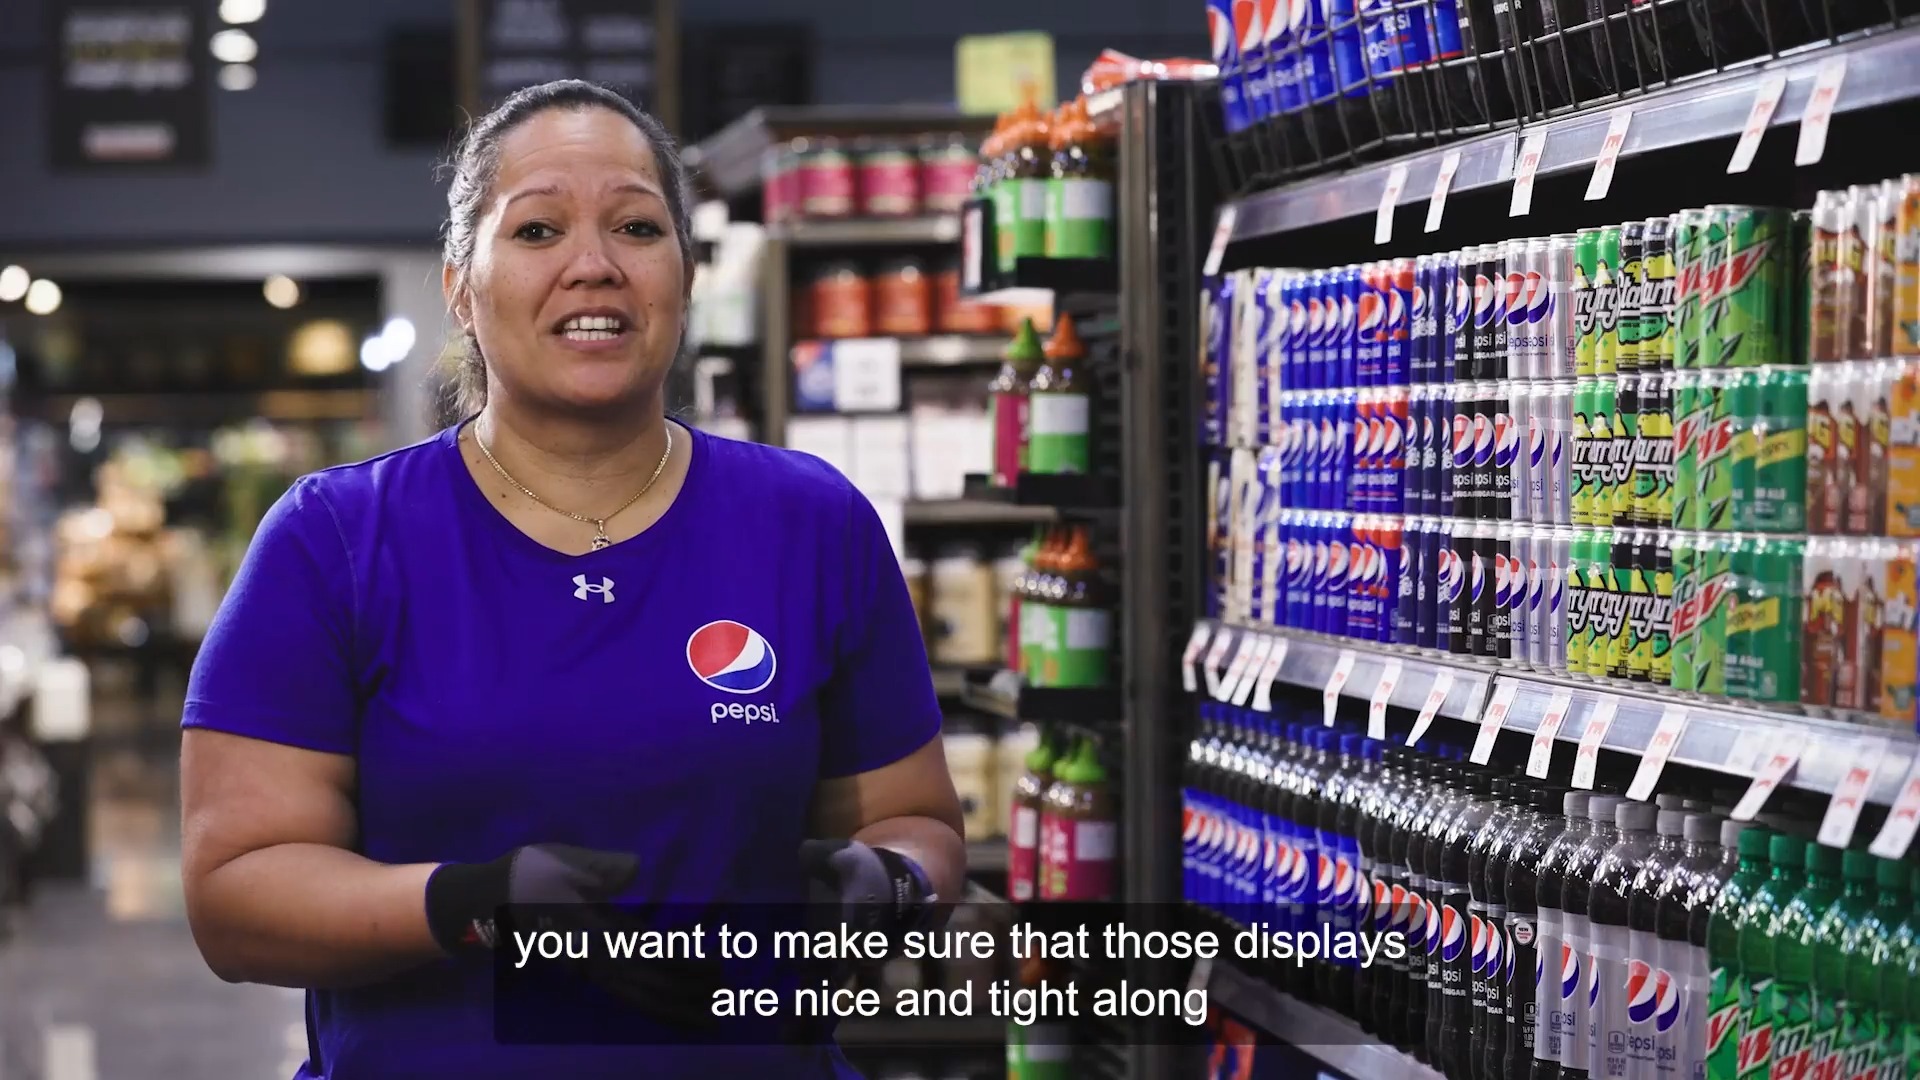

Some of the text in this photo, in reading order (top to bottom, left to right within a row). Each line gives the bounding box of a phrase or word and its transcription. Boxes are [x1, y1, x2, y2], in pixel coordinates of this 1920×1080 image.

[711, 703, 777, 724] pepsi
[1443, 969, 1461, 984] epsi
[1629, 1035, 1655, 1052] epsi
